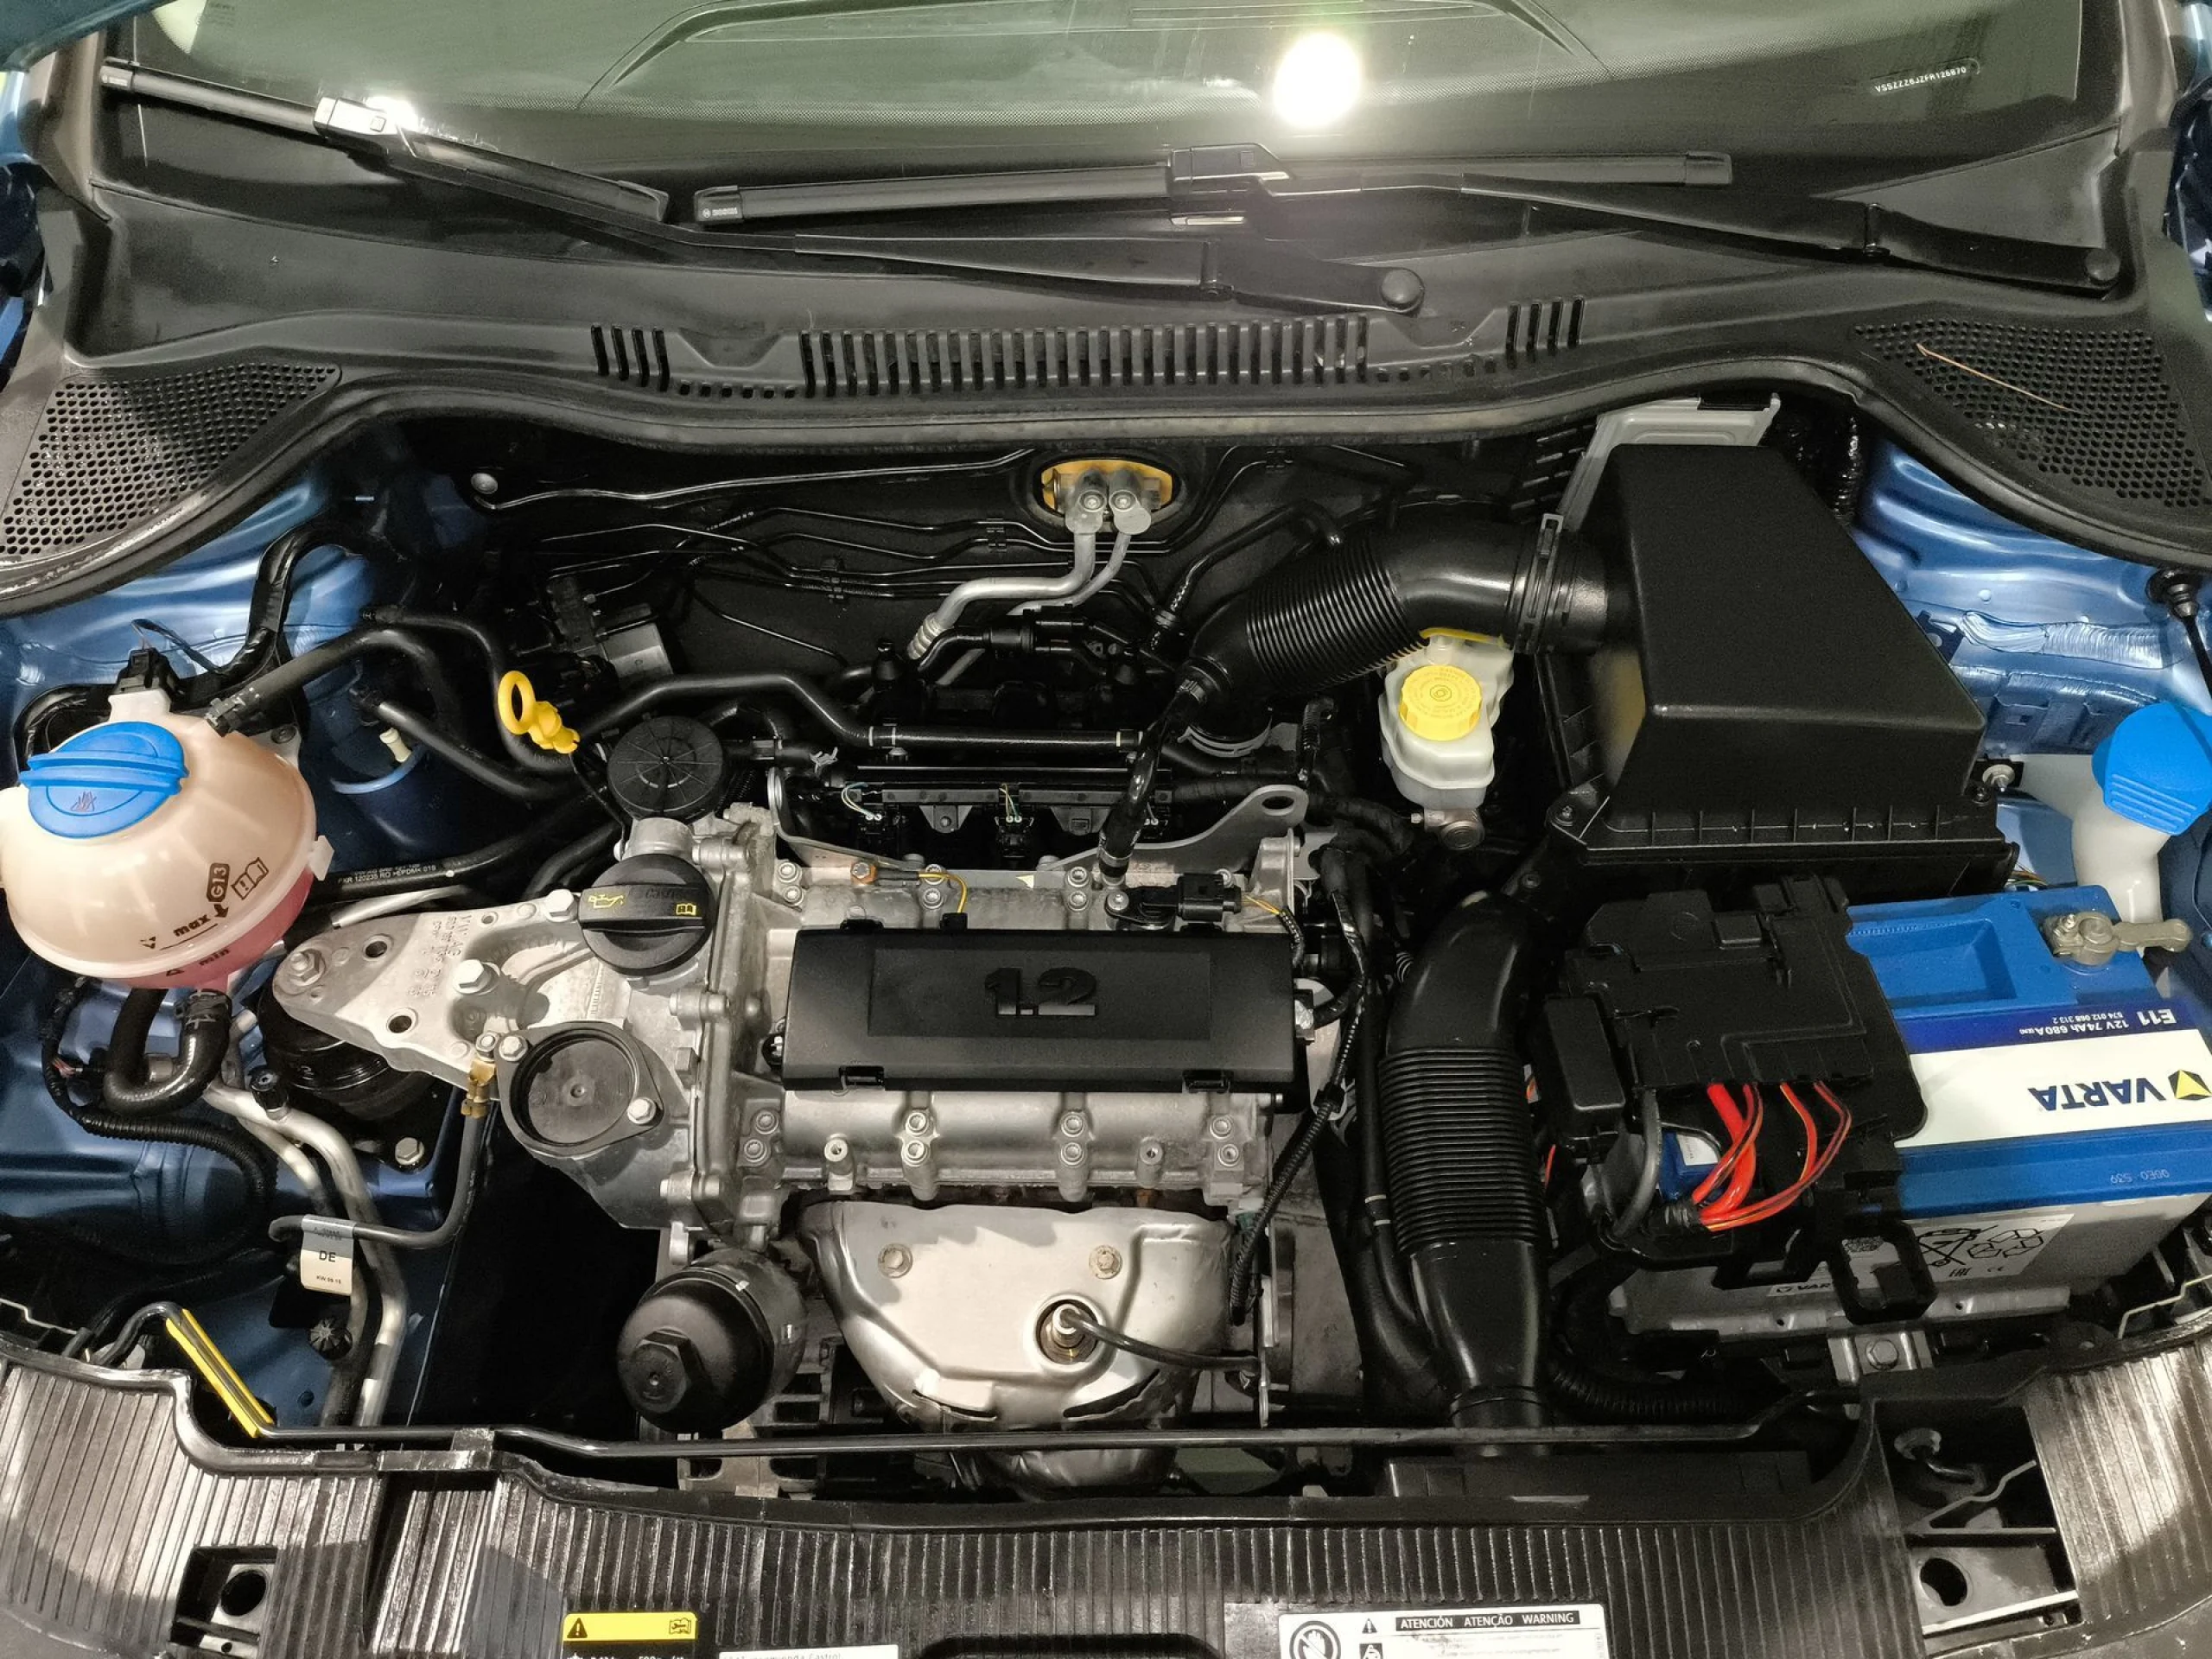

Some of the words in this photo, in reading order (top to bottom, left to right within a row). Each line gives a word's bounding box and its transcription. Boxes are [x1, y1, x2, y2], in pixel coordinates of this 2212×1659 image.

[210, 867, 226, 898] G13
[174, 914, 211, 937] max
[199, 949, 231, 966] min
[985, 967, 1097, 1016] 1.2
[2107, 1020, 2129, 1029] 12V
[2137, 1008, 2177, 1026] E11
[2070, 1022, 2102, 1033] 74Ah
[2028, 1077, 2166, 1111] VARTA
[319, 1250, 336, 1262] DE
[1400, 1615, 1453, 1629] ATENCIÓN
[1464, 1613, 1513, 1629] ATENÇÃO
[1521, 1612, 1574, 1625] WARNING
